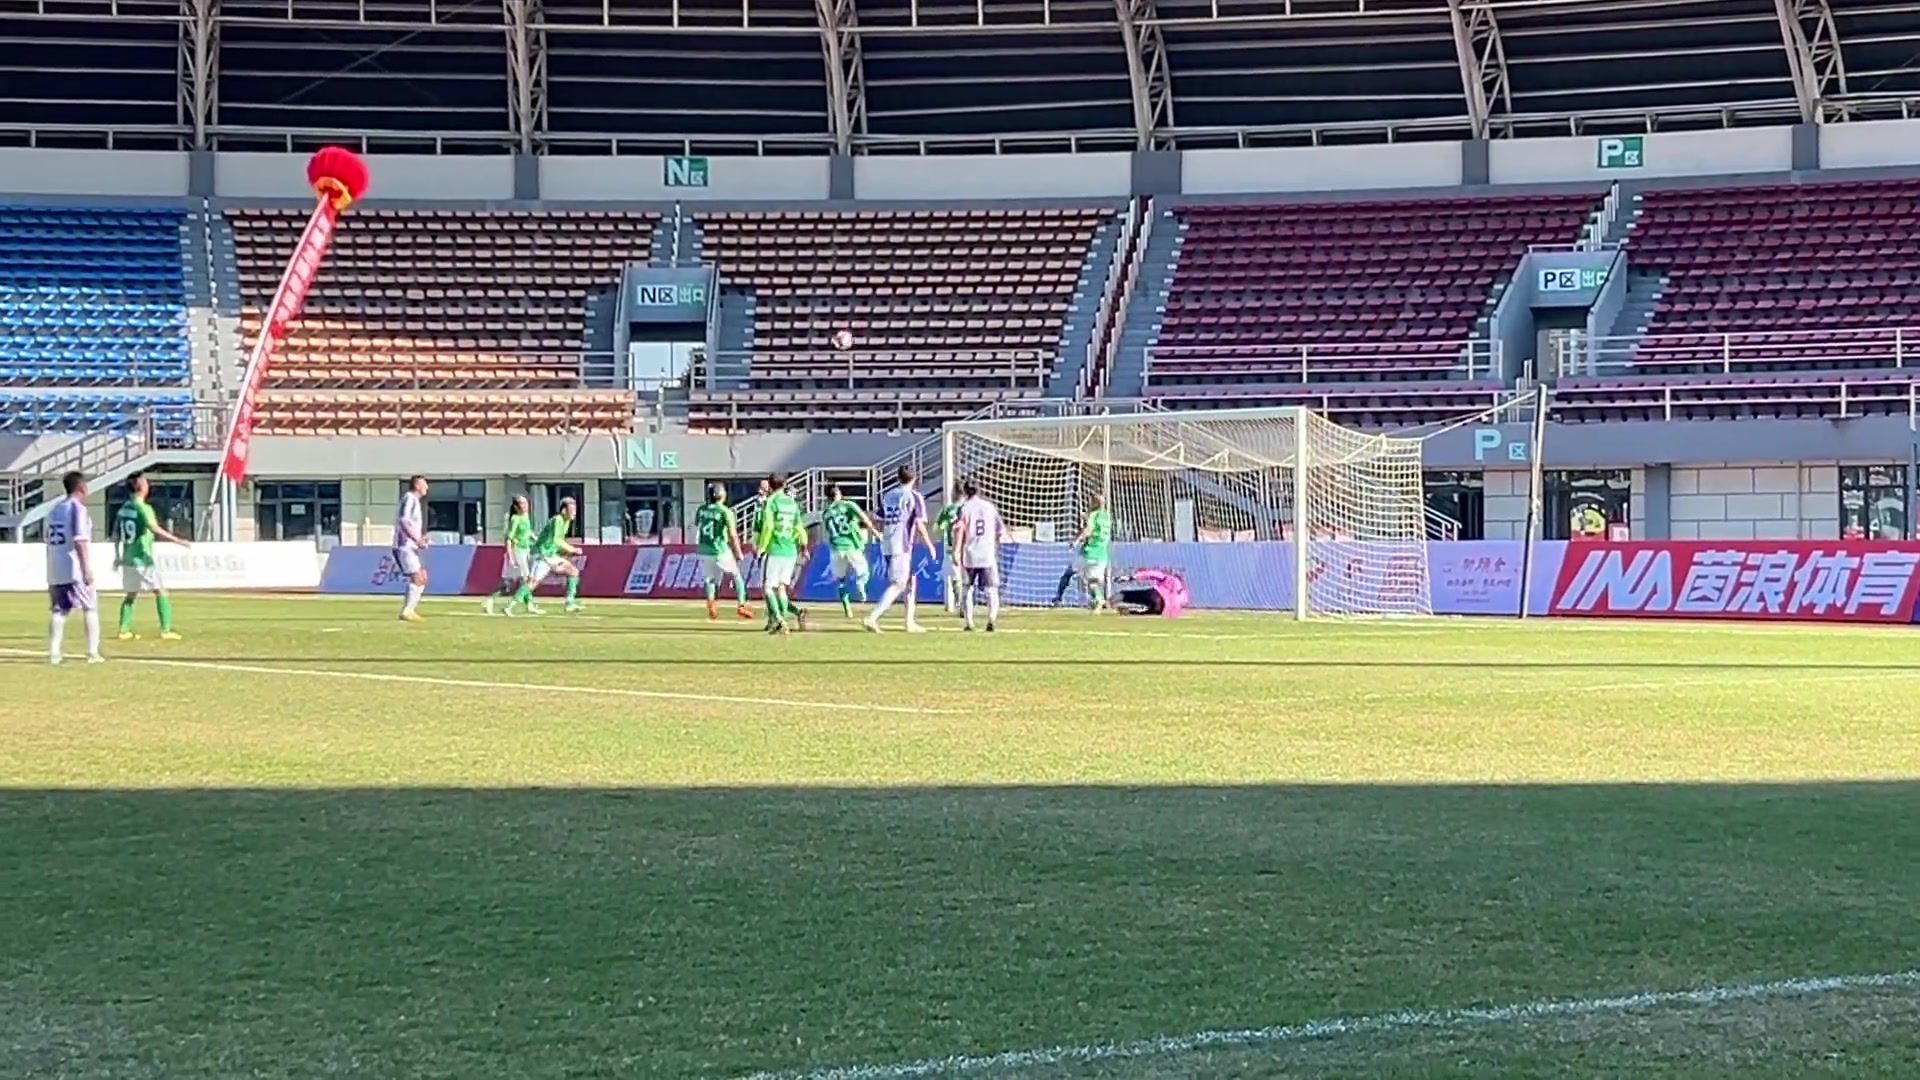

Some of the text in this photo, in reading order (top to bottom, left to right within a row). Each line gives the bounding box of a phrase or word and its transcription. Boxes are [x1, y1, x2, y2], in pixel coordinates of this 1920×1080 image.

[1600, 139, 1640, 166] P区
[667, 158, 705, 186] N区
[49, 523, 66, 545] 25
[119, 520, 136, 544] 19
[975, 520, 986, 536] 8
[1557, 549, 1919, 615] INA 茵浪体育
